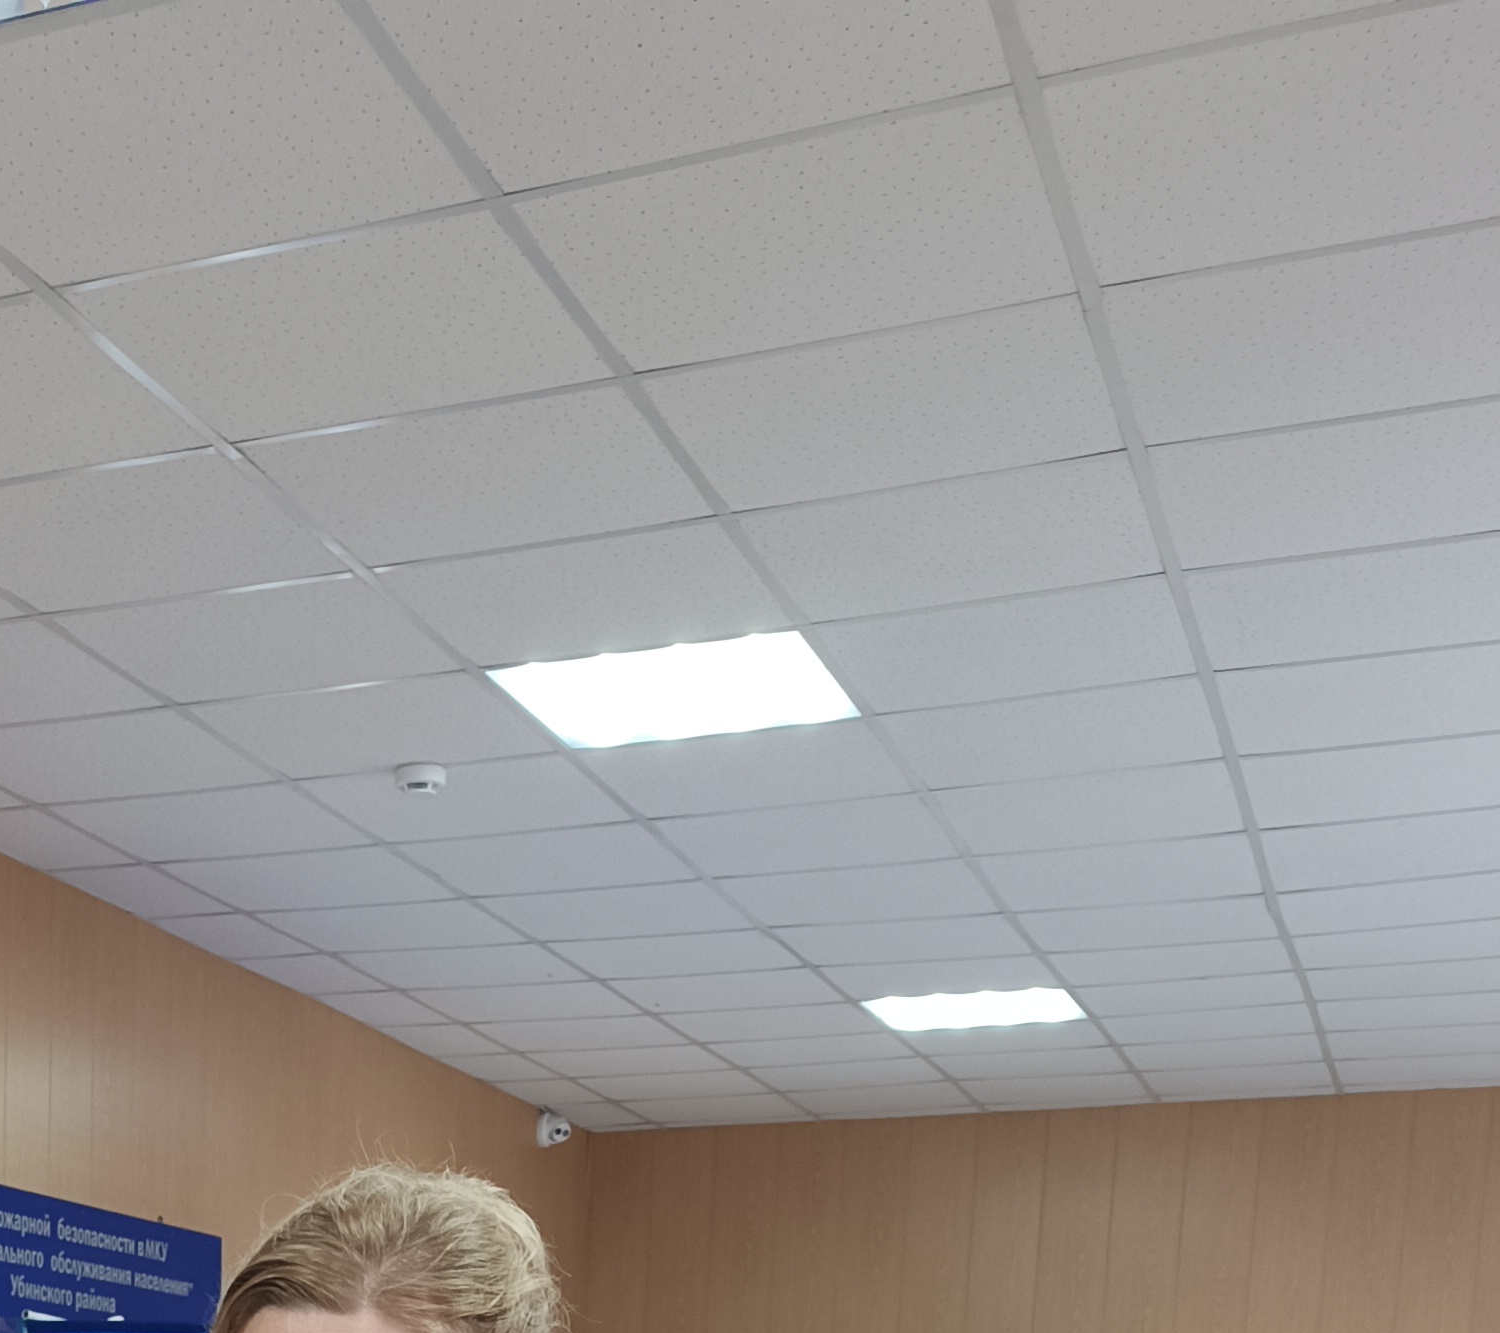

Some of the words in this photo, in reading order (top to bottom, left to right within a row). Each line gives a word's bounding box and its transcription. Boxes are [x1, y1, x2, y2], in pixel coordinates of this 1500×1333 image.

[56, 1217, 136, 1256] безопасности
[144, 1239, 169, 1263] МКУ
[50, 1250, 132, 1286] обслуживания
[10, 1273, 73, 1307] Убинского
[75, 1287, 117, 1314] района
